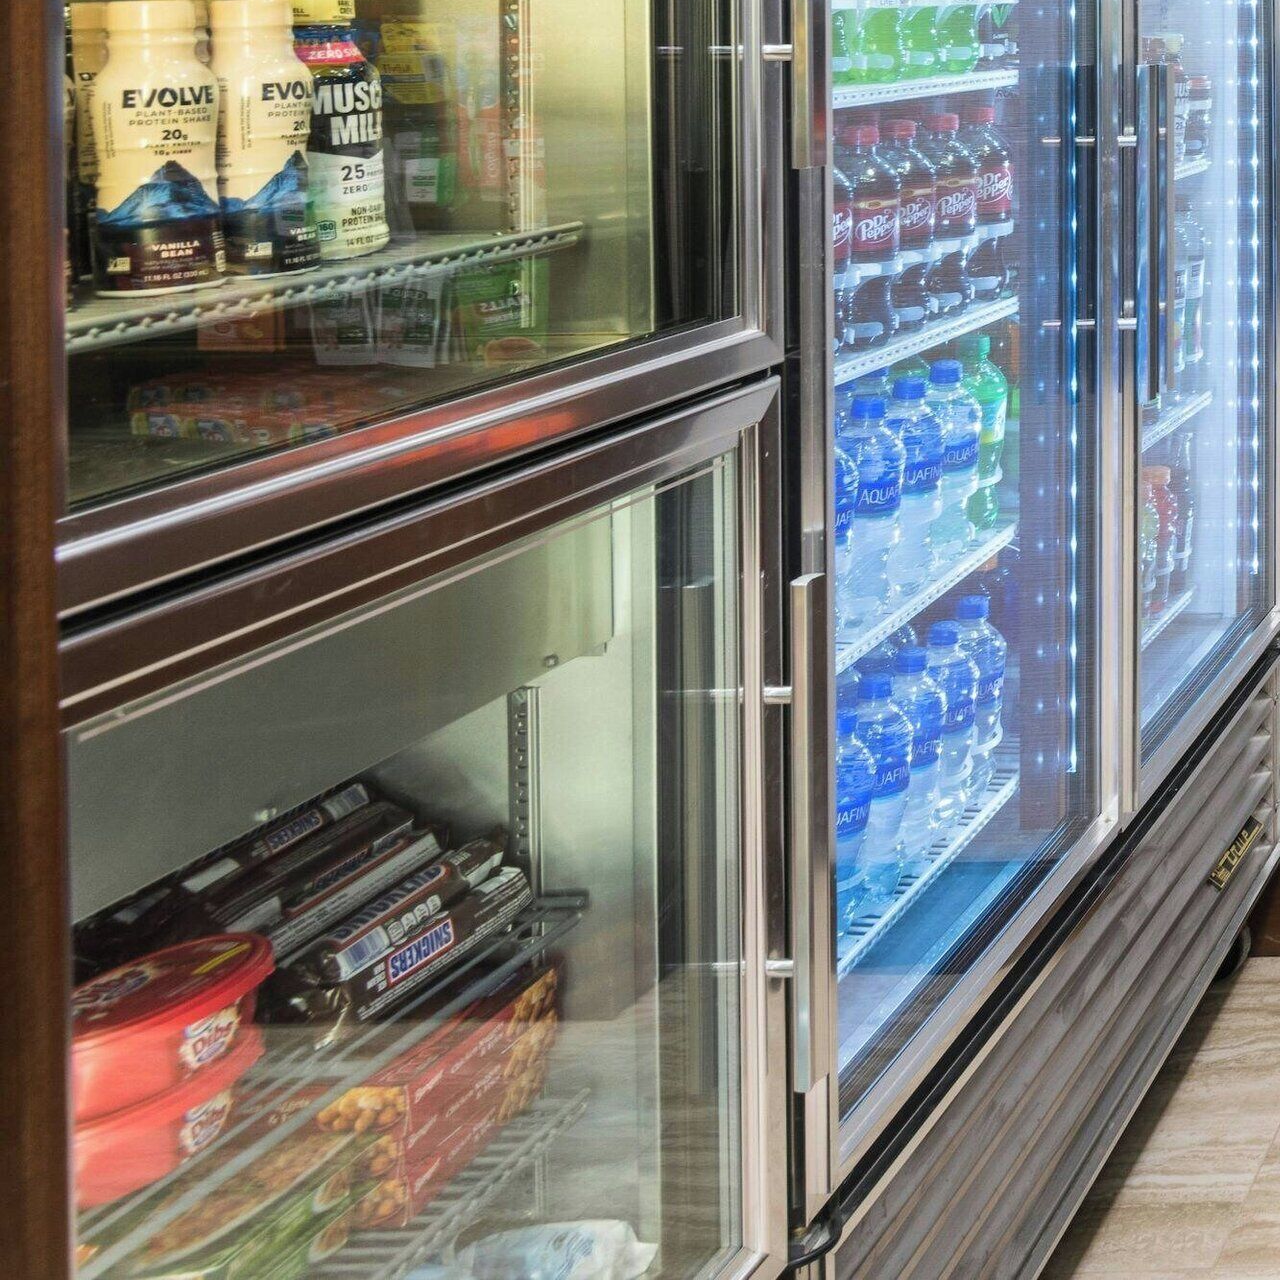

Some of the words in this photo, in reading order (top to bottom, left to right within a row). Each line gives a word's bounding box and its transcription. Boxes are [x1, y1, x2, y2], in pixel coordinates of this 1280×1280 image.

[308, 48, 342, 60] ZERO
[122, 85, 214, 109] EVOLVE
[135, 107, 208, 118] PLANT-BASED
[129, 116, 179, 126] PROTEIN
[182, 115, 212, 124] SHAKE
[162, 129, 188, 141] 20g
[342, 165, 365, 182] 25
[983, 172, 1000, 187] Dr
[342, 184, 368, 195] ZERO
[951, 191, 967, 205] Dr
[940, 195, 973, 216] Pepper
[872, 214, 889, 226] Dr
[862, 218, 897, 241] Pepper
[151, 241, 200, 251] VANILLA
[161, 248, 193, 258] BEAN
[390, 921, 451, 980] SNICKERS
